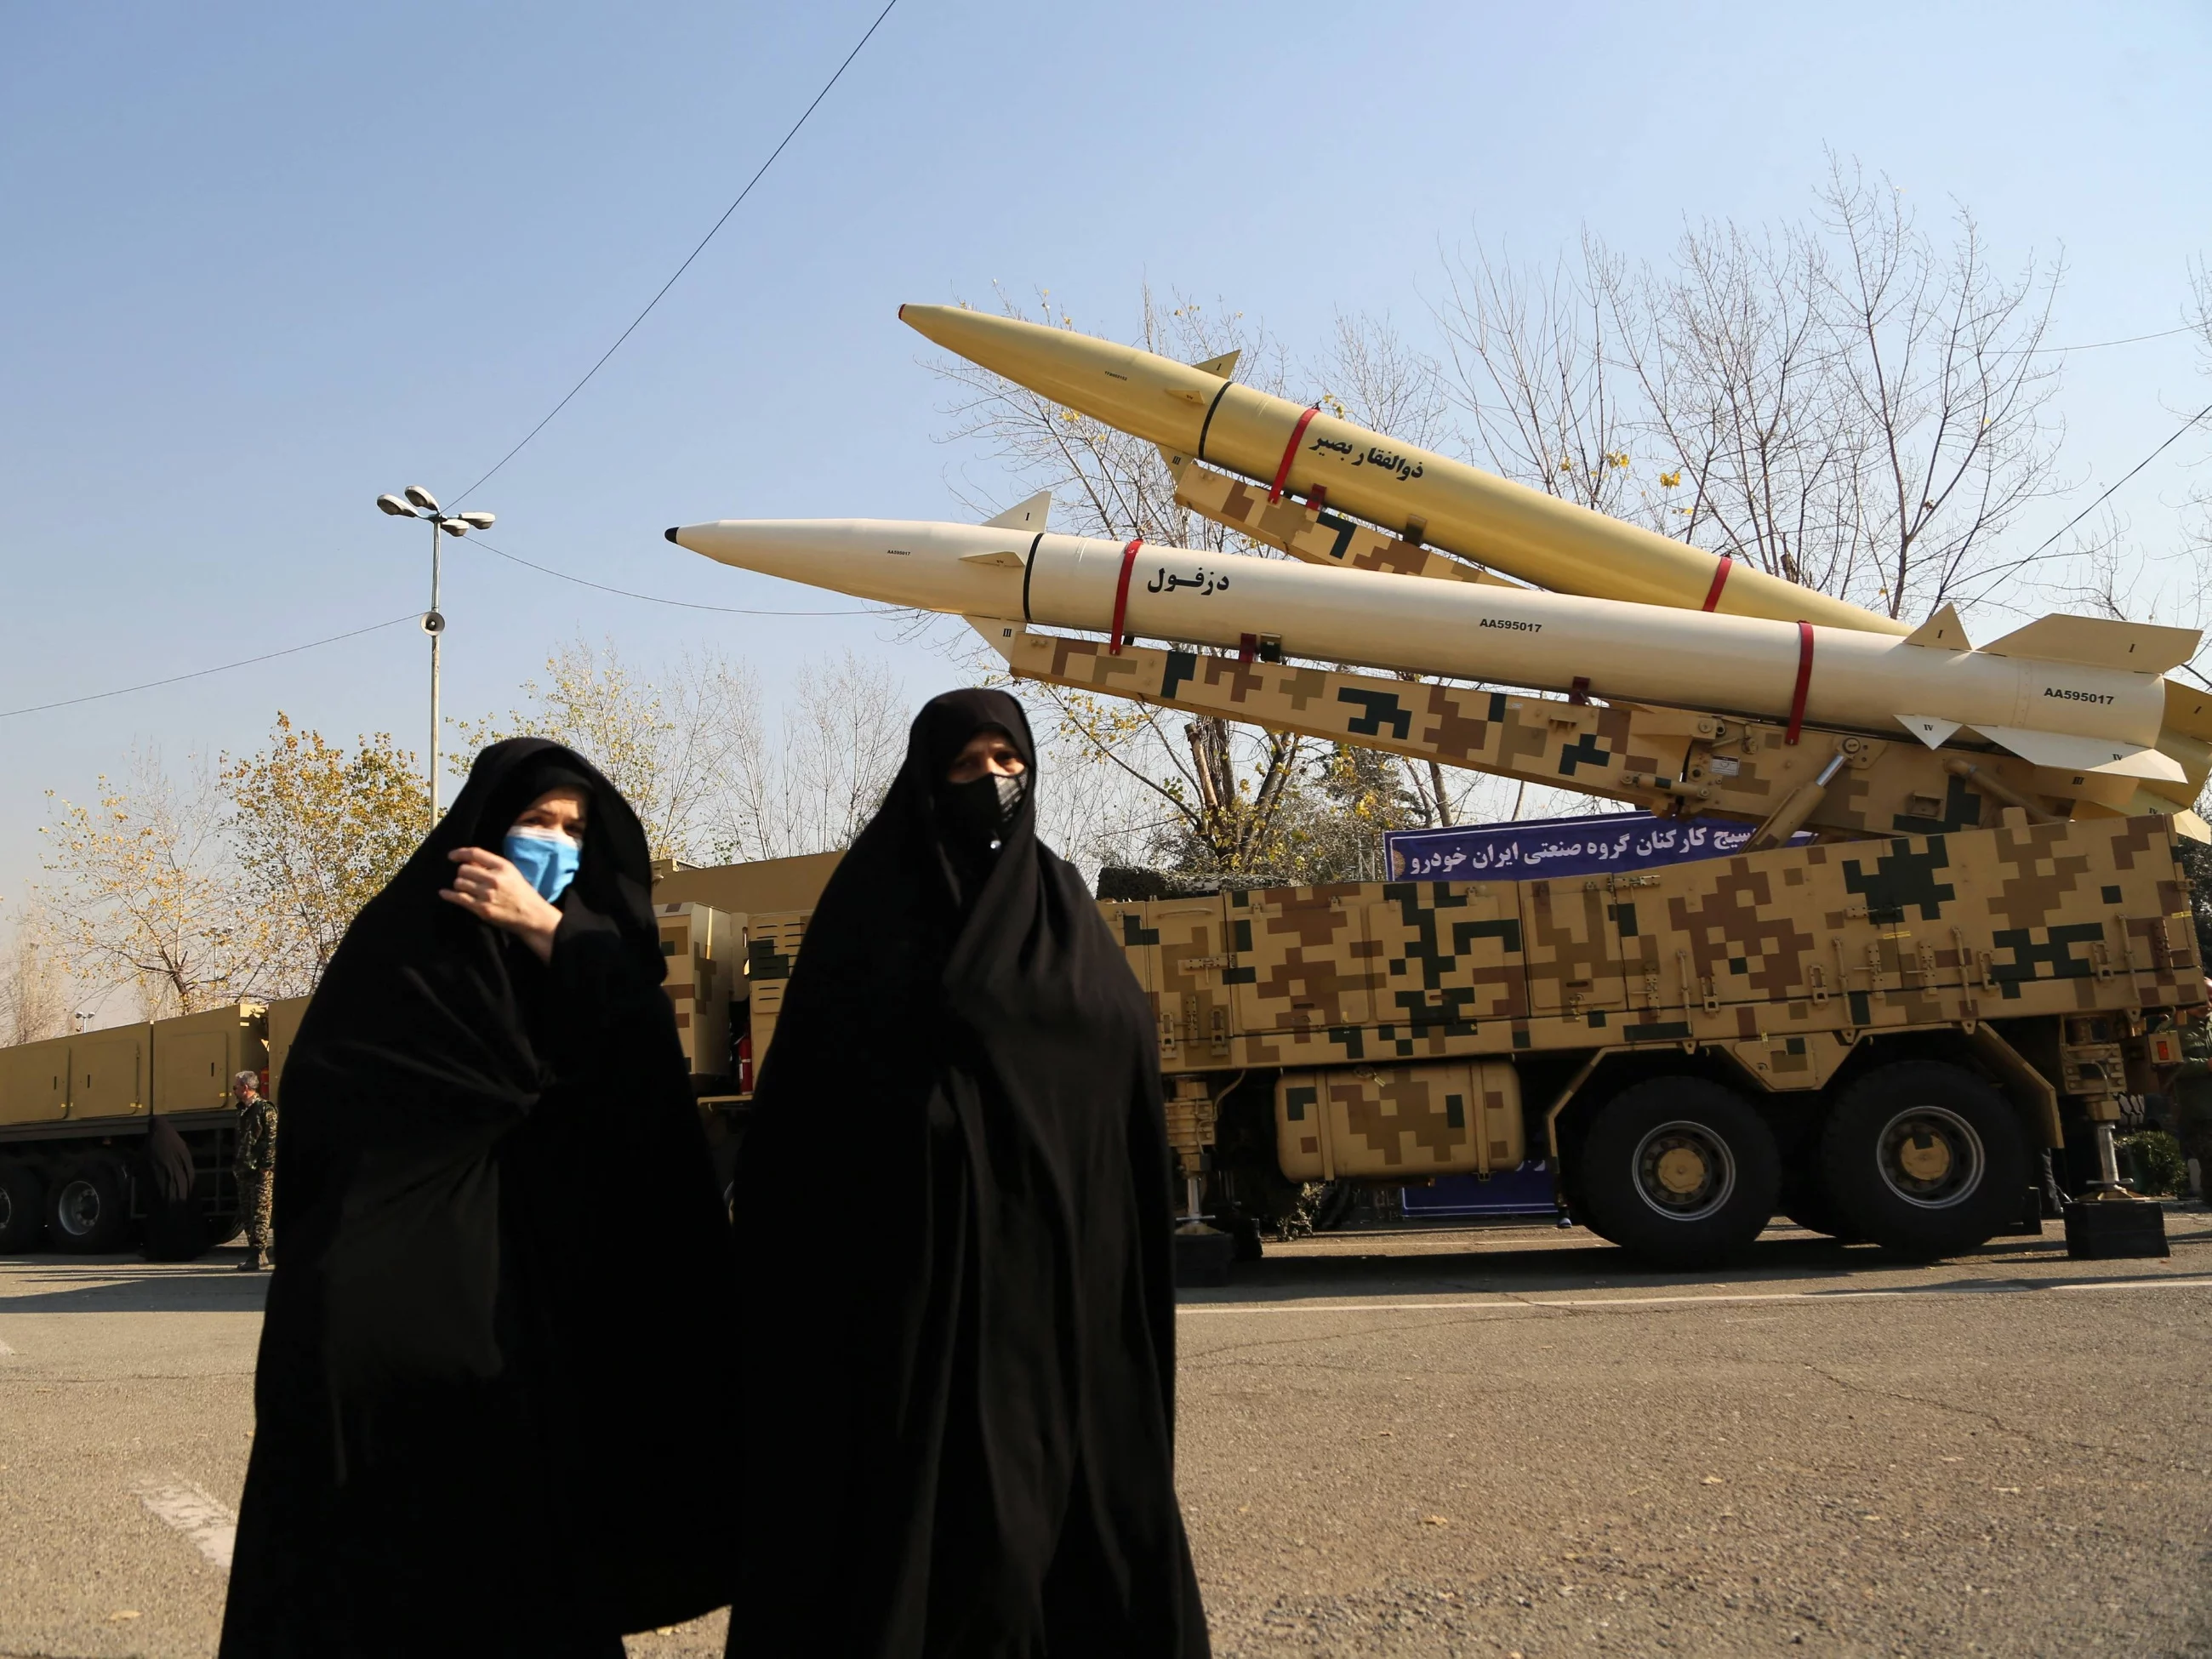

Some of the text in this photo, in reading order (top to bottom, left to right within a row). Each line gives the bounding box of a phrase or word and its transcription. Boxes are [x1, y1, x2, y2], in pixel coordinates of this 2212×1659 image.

[1308, 437, 1423, 482] ذوالفقار بصیر
[1025, 512, 1030, 521] I
[1147, 567, 1229, 596] دزفول
[1479, 618, 1542, 633] AA595017
[1937, 630, 1943, 639] I
[2129, 643, 2135, 653] I
[2044, 687, 2114, 705] AA595017
[2194, 705, 2202, 715] I
[1587, 833, 1630, 860] گروه
[1713, 828, 1757, 850] سیج
[1410, 847, 1468, 875] خودرو
[1472, 841, 1519, 869] ایران
[1524, 841, 1582, 865] صنعتی
